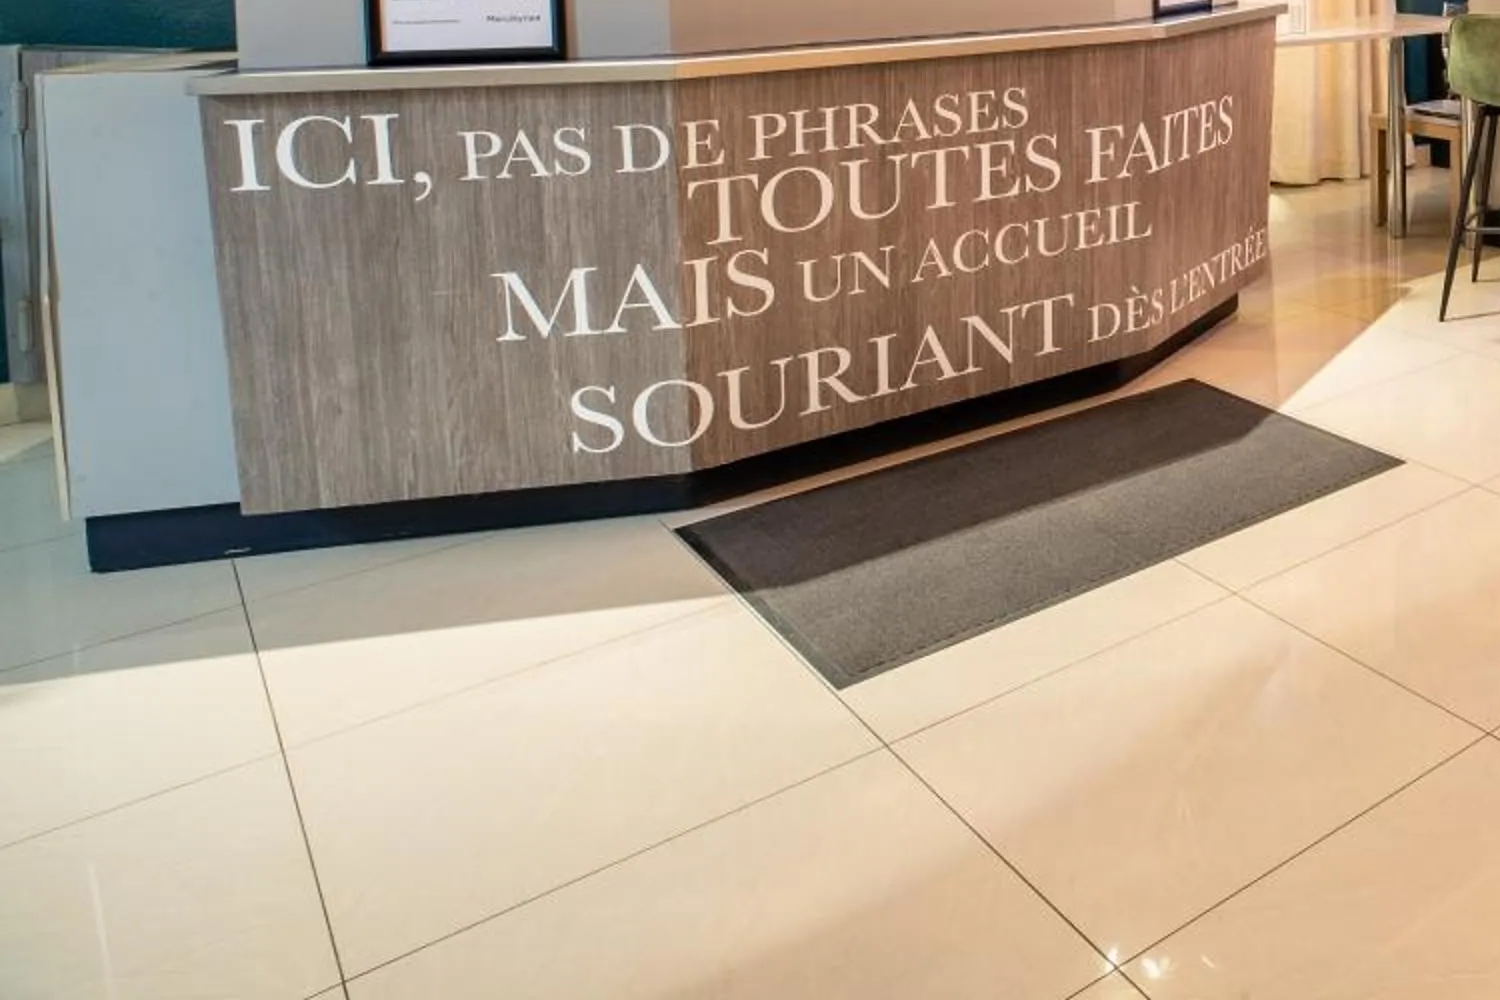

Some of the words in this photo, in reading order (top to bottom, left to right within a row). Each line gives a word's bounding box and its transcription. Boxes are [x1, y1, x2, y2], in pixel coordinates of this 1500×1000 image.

[223, 112, 433, 201] ICI,
[456, 126, 592, 182] PAS
[613, 118, 725, 175] DE
[748, 86, 1030, 161] PHRASES
[687, 133, 1062, 246] TOUTES
[1084, 94, 1234, 185] FAITES
[490, 247, 775, 342] MAIS
[798, 244, 896, 302] UN
[911, 201, 1153, 283] ACCUEIL
[570, 294, 1074, 454] SOURIANT
[1087, 284, 1164, 344] DÈS
